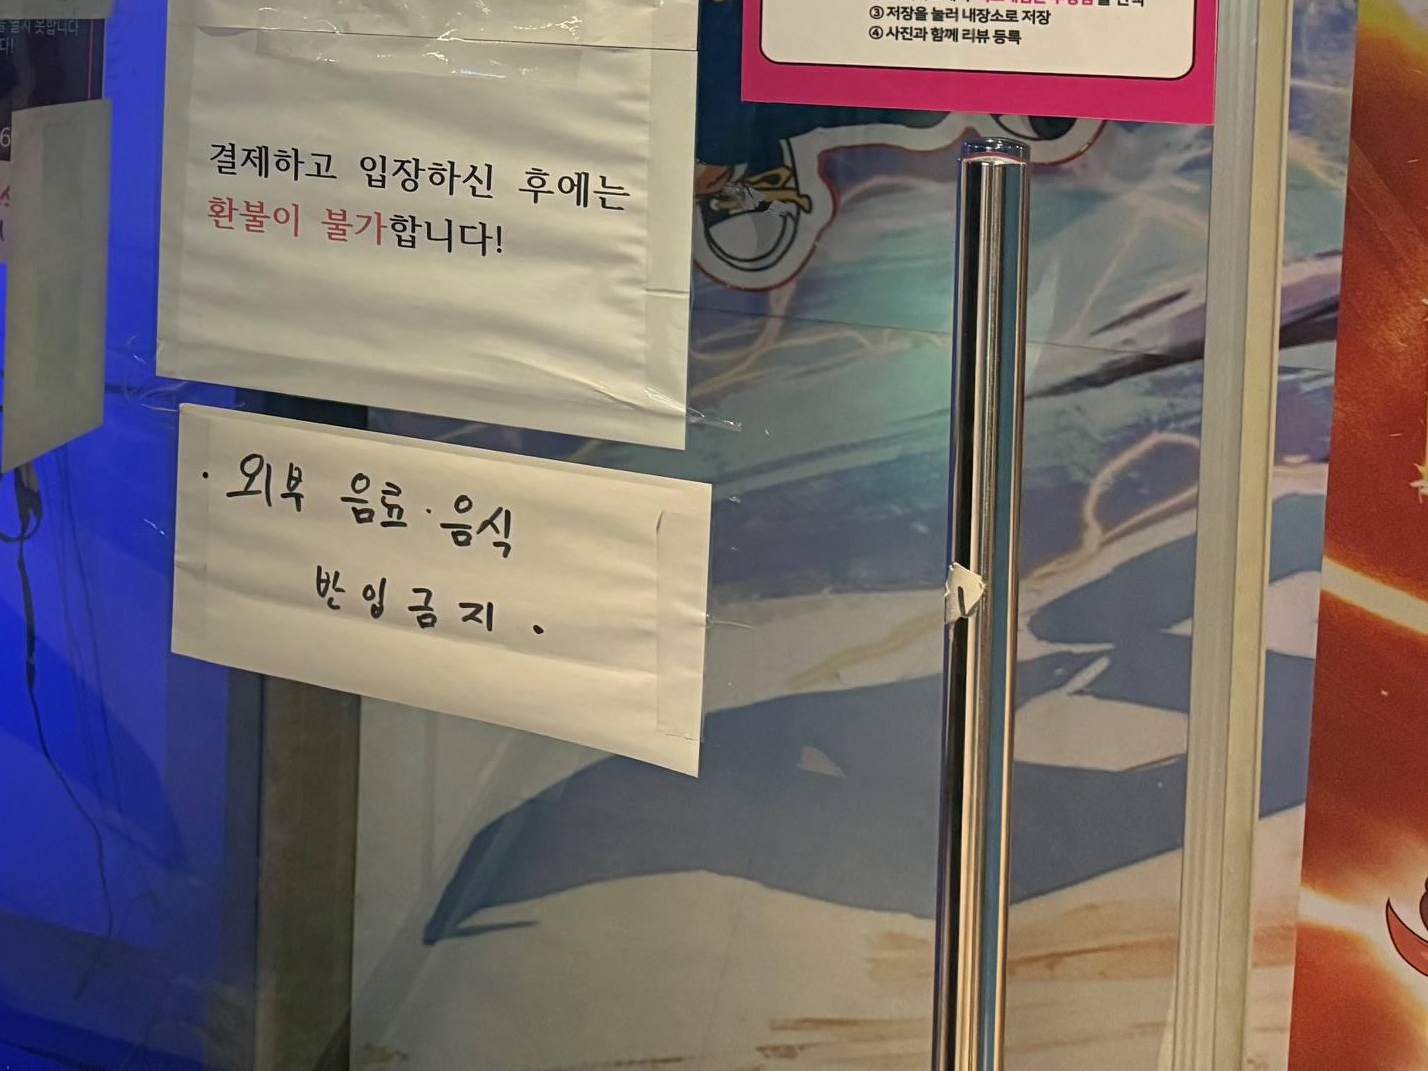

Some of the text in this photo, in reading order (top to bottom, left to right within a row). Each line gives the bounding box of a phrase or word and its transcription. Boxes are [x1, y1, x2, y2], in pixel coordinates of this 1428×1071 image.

[885, 25, 928, 42] 사진과
[930, 26, 960, 43] 함께
[962, 27, 990, 44] 리뷰
[992, 28, 1023, 45] 등록
[886, 5, 928, 22] 저장을
[930, 6, 960, 23] 눌러
[961, 7, 1019, 25] 내장소로
[1021, 8, 1051, 26] 저장
[209, 142, 632, 212] 결제하고 입장하신 후에는
[207, 195, 504, 258] 환불이 불가합니다!
[225, 452, 305, 513] 외부
